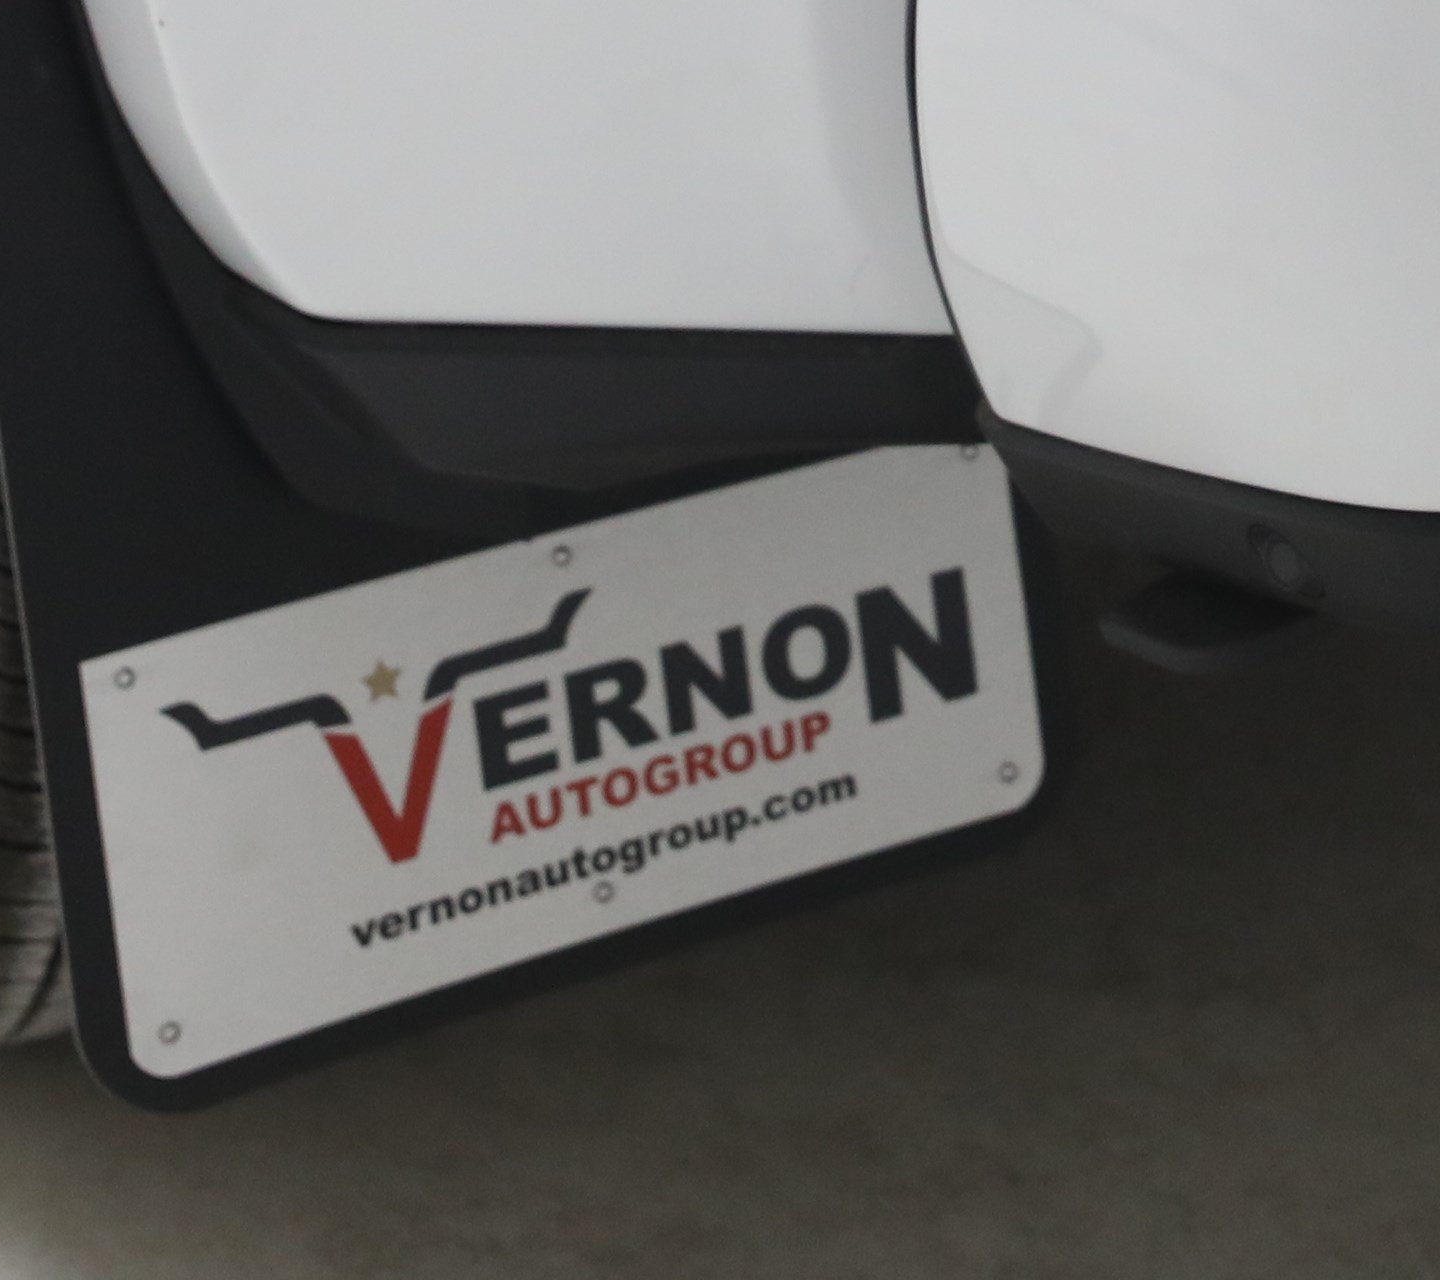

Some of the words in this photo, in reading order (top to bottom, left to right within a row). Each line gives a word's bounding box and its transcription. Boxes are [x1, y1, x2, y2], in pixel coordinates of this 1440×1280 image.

[324, 565, 979, 865] VERNON
[488, 710, 833, 845] AUTOGROUP
[349, 770, 858, 949] vernonautogroup.com
